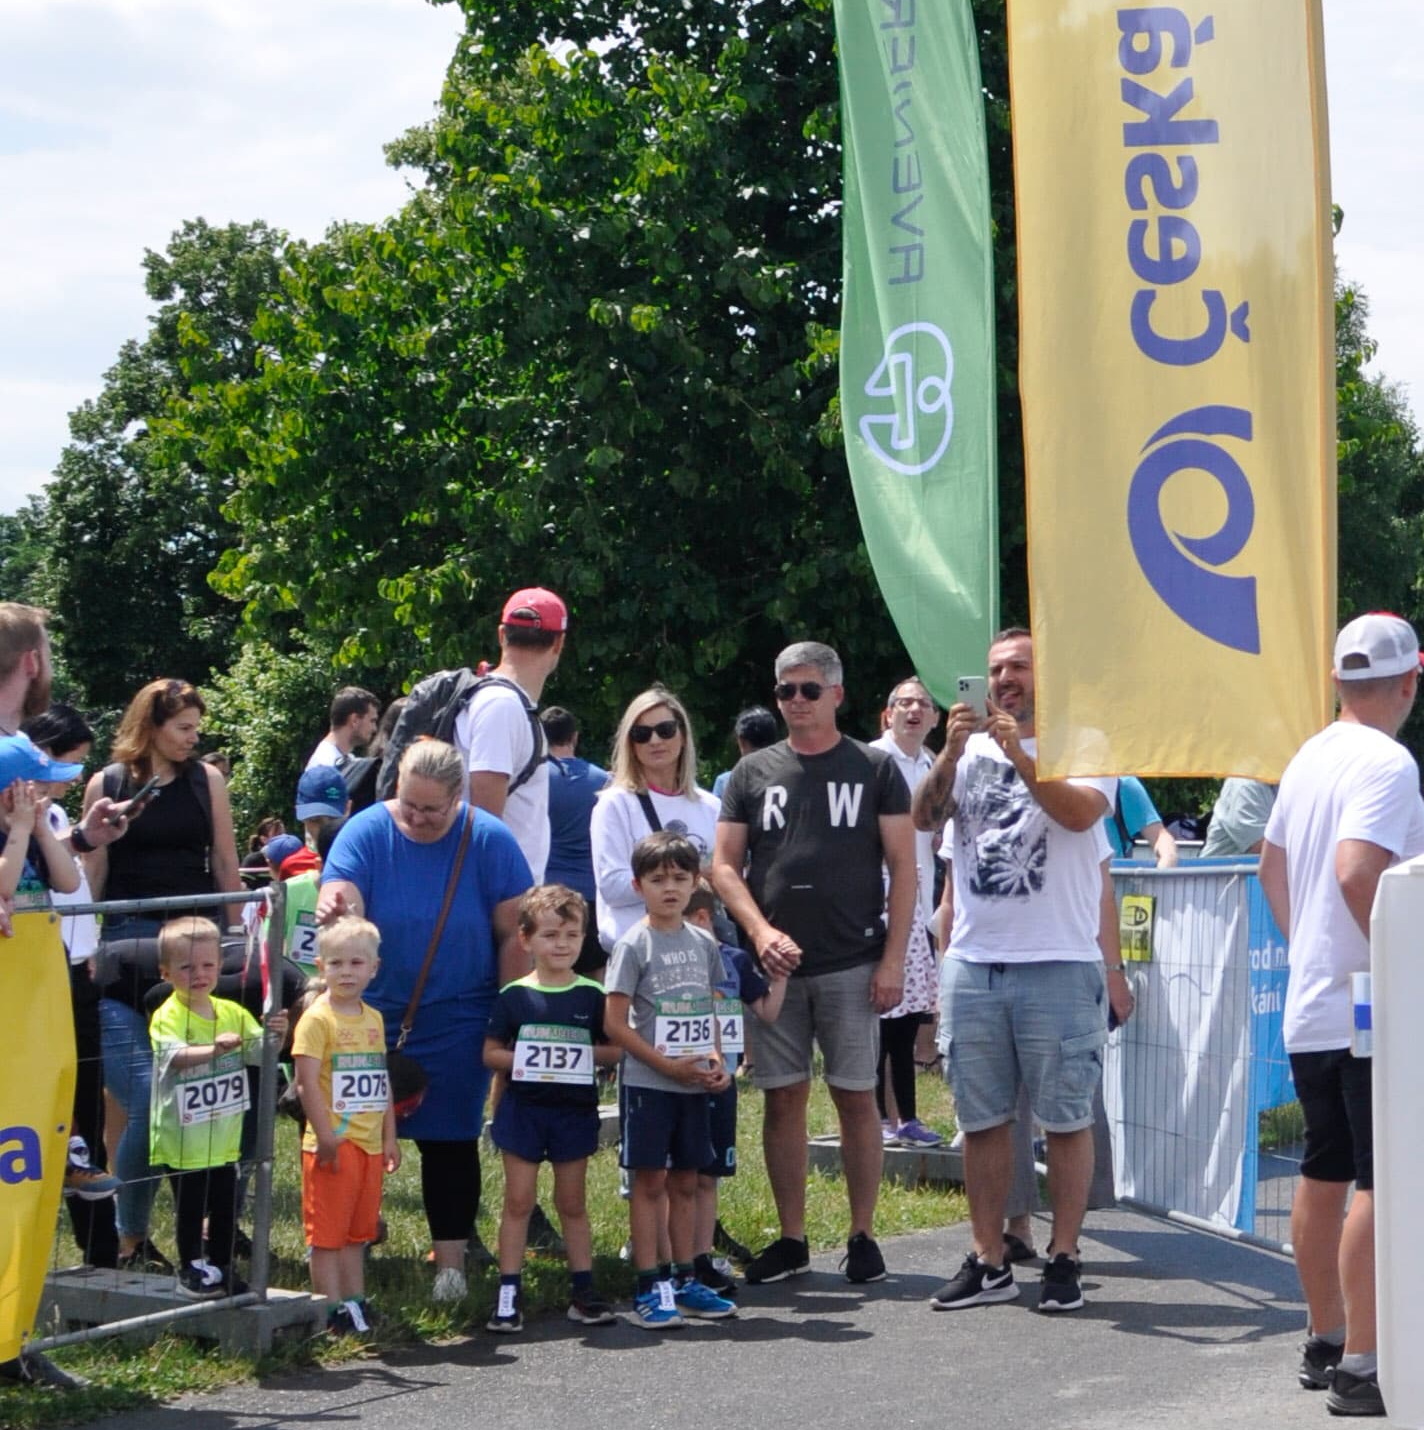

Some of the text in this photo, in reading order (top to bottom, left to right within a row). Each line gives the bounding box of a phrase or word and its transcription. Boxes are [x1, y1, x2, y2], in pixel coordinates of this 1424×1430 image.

[827, 781, 864, 828] W
[660, 950, 687, 966] WHO
[665, 1018, 710, 1043] 2136
[525, 1045, 583, 1070] 2137
[185, 1075, 244, 1110] 2079
